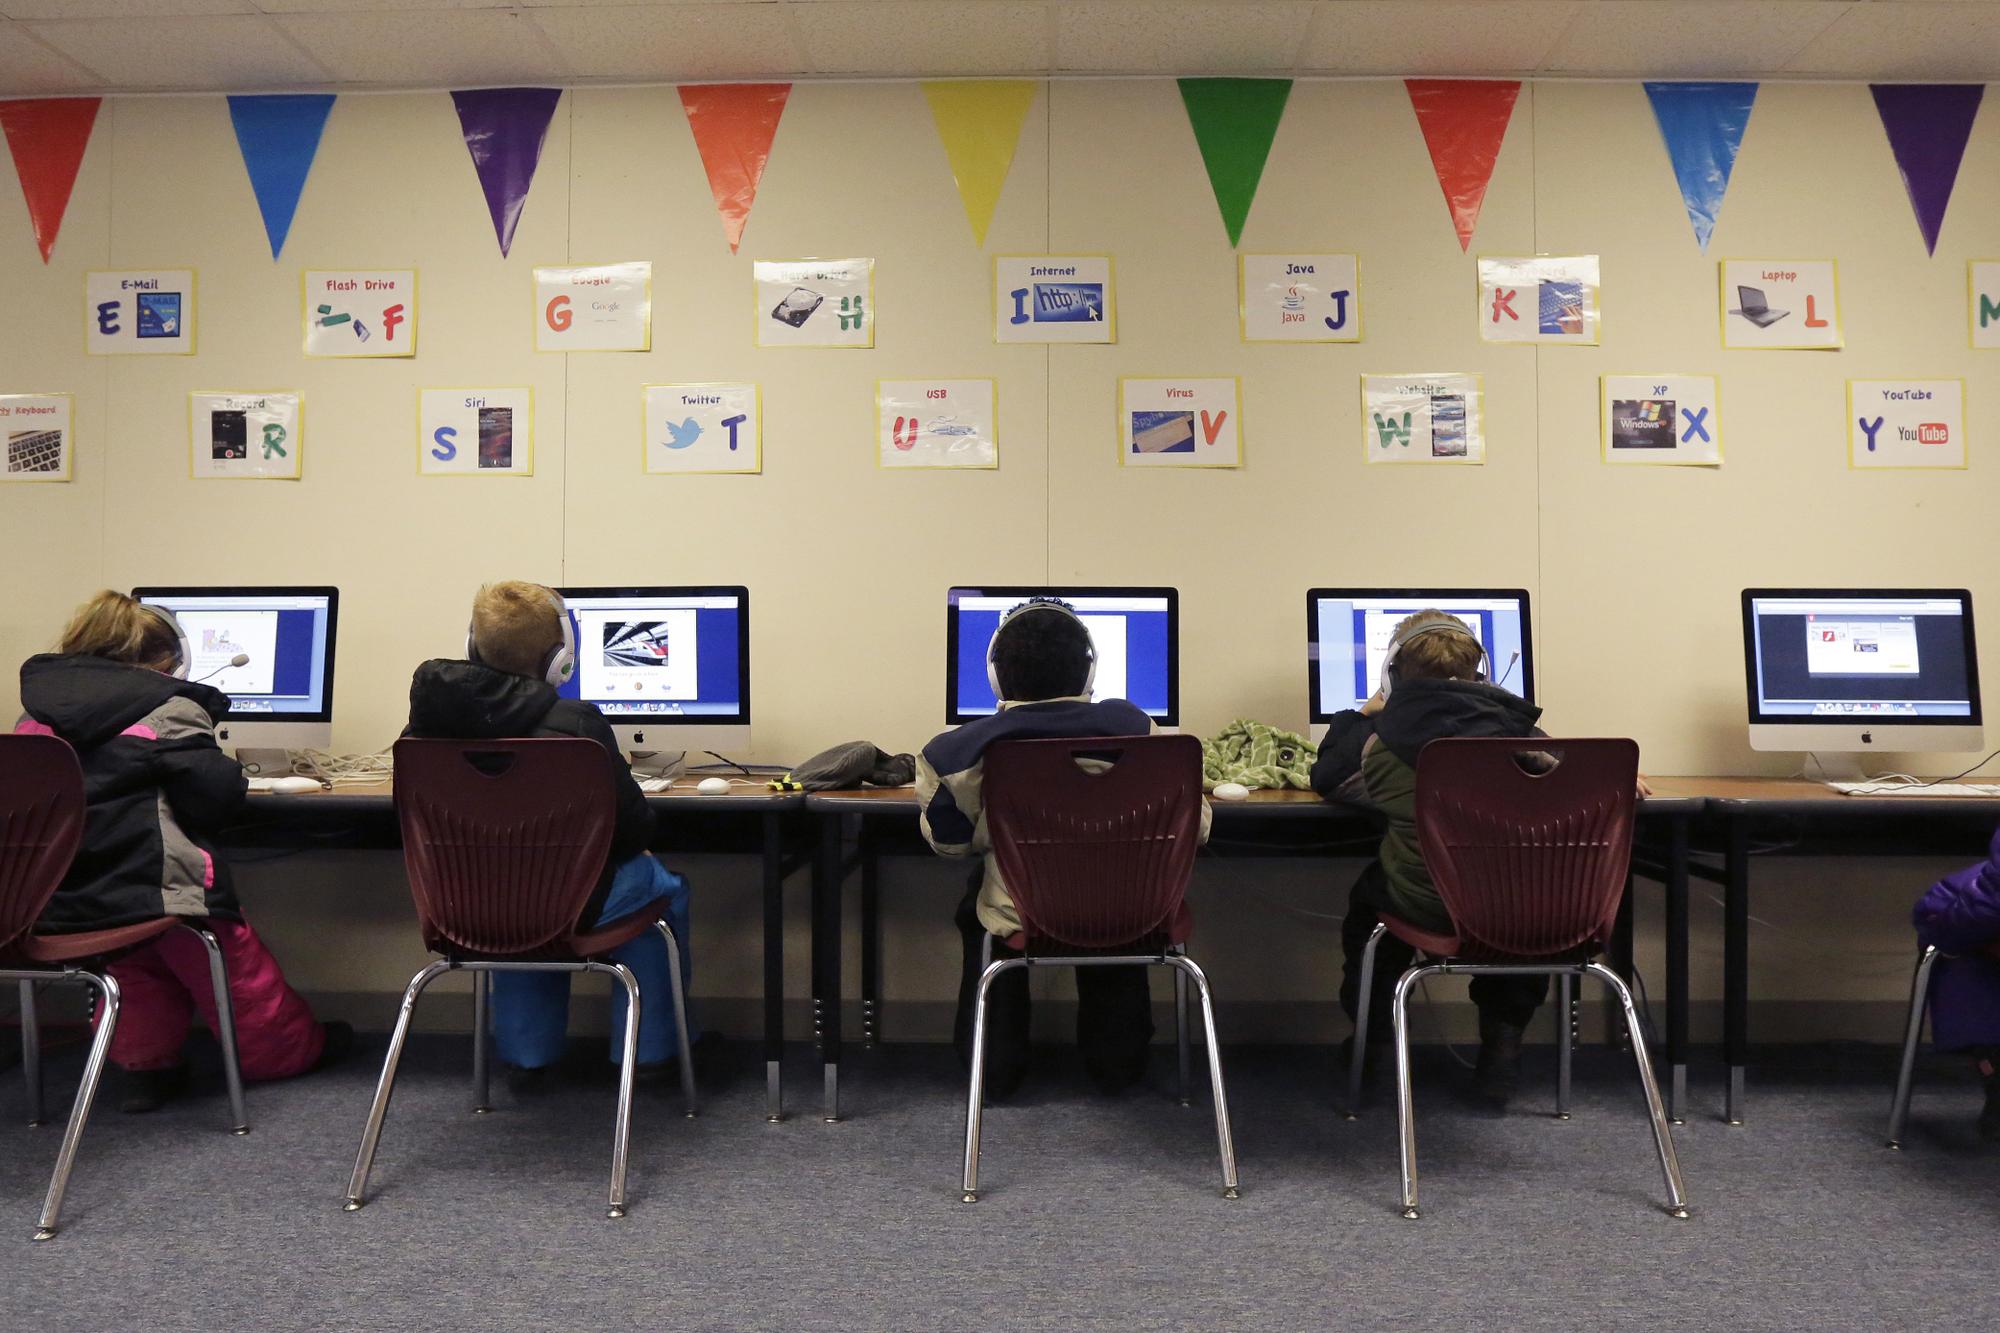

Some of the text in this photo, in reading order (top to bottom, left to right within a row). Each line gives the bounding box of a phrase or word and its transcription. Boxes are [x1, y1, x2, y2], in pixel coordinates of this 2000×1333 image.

[1030, 266, 1076, 276] Internet
[1286, 263, 1315, 275] Java
[1762, 271, 1797, 282] Laptop
[121, 279, 159, 290] E-Mail
[326, 280, 395, 290] Flash Drive
[546, 295, 573, 332] G
[591, 302, 621, 312] Google
[837, 295, 864, 331] H
[1010, 288, 1030, 325] I
[1325, 290, 1350, 330] J
[1492, 288, 1519, 323] K
[1804, 294, 1829, 327] L
[97, 301, 121, 335] E
[383, 303, 404, 341] F
[1282, 312, 1305, 324] Java
[681, 395, 721, 405] Twitter
[927, 389, 948, 399] USB
[1166, 388, 1194, 398] Virus
[1653, 385, 1668, 396] XP
[1882, 389, 1932, 400] YouTube
[15, 406, 56, 416] Keyboard
[225, 399, 266, 409] Record
[465, 397, 486, 407] Siri
[721, 414, 747, 451] T
[893, 416, 918, 451] U
[1200, 409, 1227, 445] V
[1374, 412, 1412, 449] W
[1620, 419, 1660, 429] Windows
[1681, 407, 1711, 443] X
[1859, 416, 1884, 452] Y
[262, 423, 287, 460] R
[431, 426, 457, 461] S
